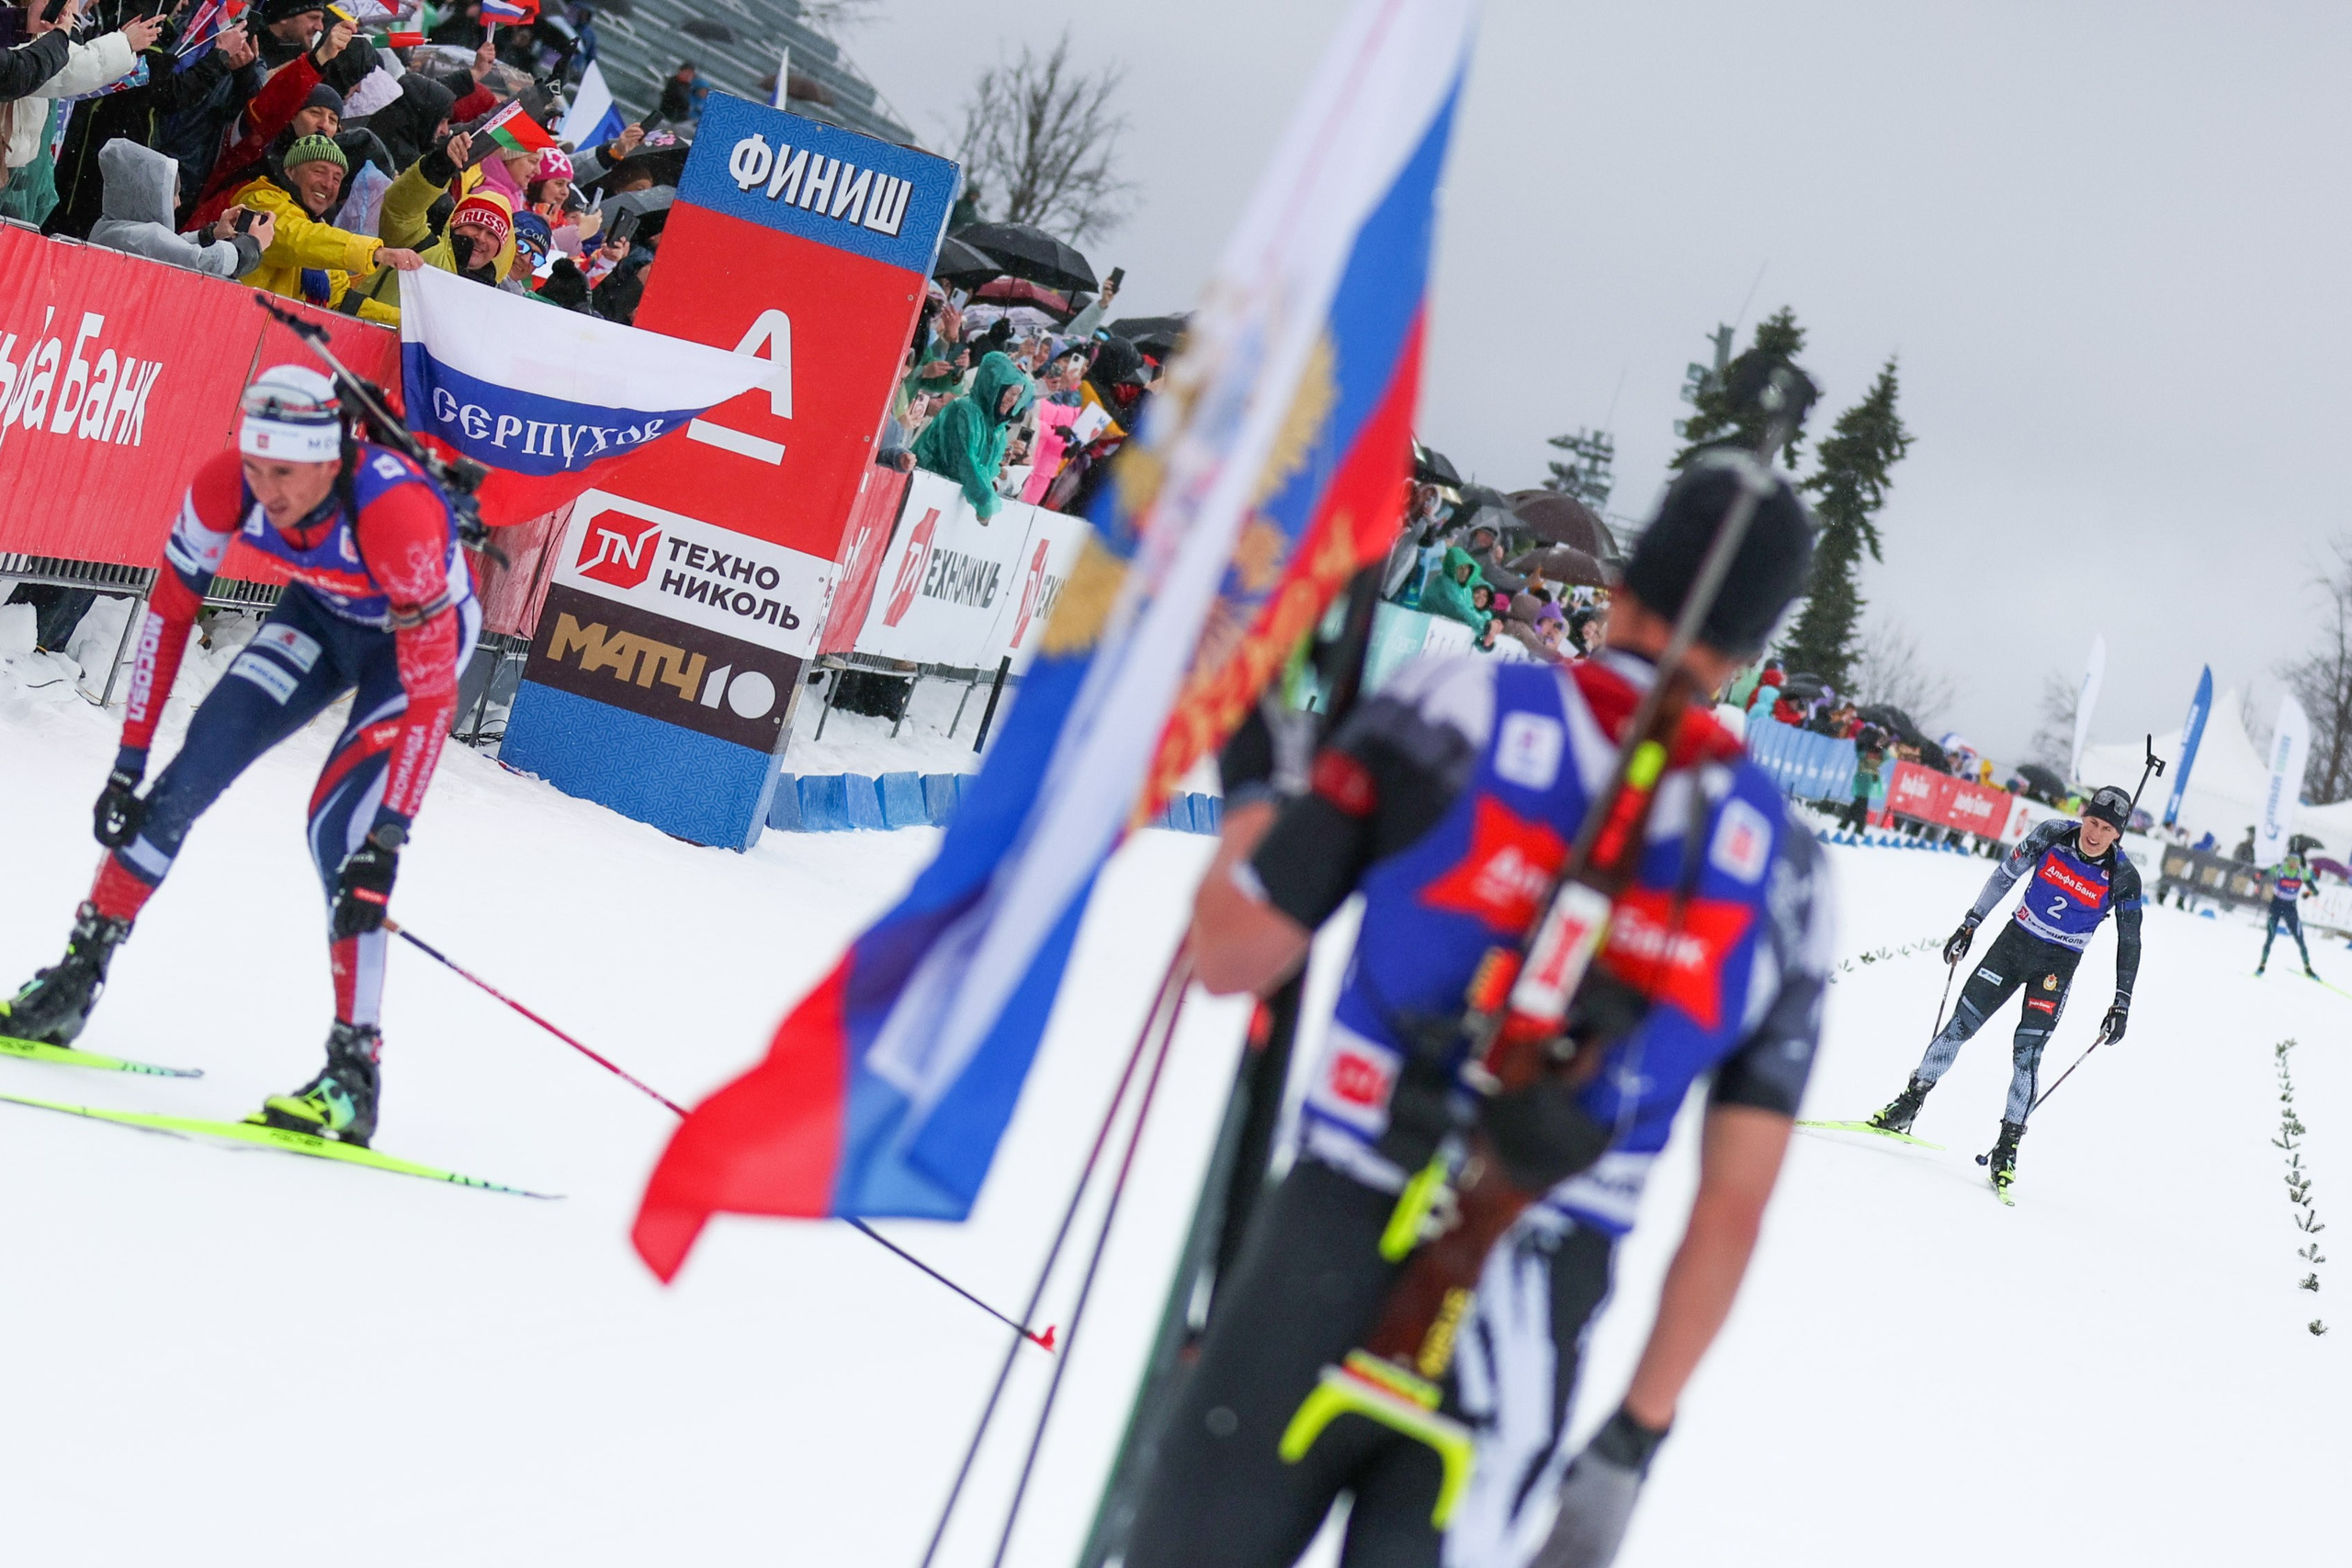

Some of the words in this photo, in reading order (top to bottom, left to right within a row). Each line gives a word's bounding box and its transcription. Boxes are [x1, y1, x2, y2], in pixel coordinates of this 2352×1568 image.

[728, 132, 915, 238] ФИНИШ
[49, 310, 164, 447] Банк
[668, 535, 781, 592] ТЕХНО
[659, 568, 800, 631] НИКОЛЬ
[2044, 864, 2076, 888] Альфа
[2075, 881, 2098, 901] Банк
[2046, 896, 2069, 920] 2
